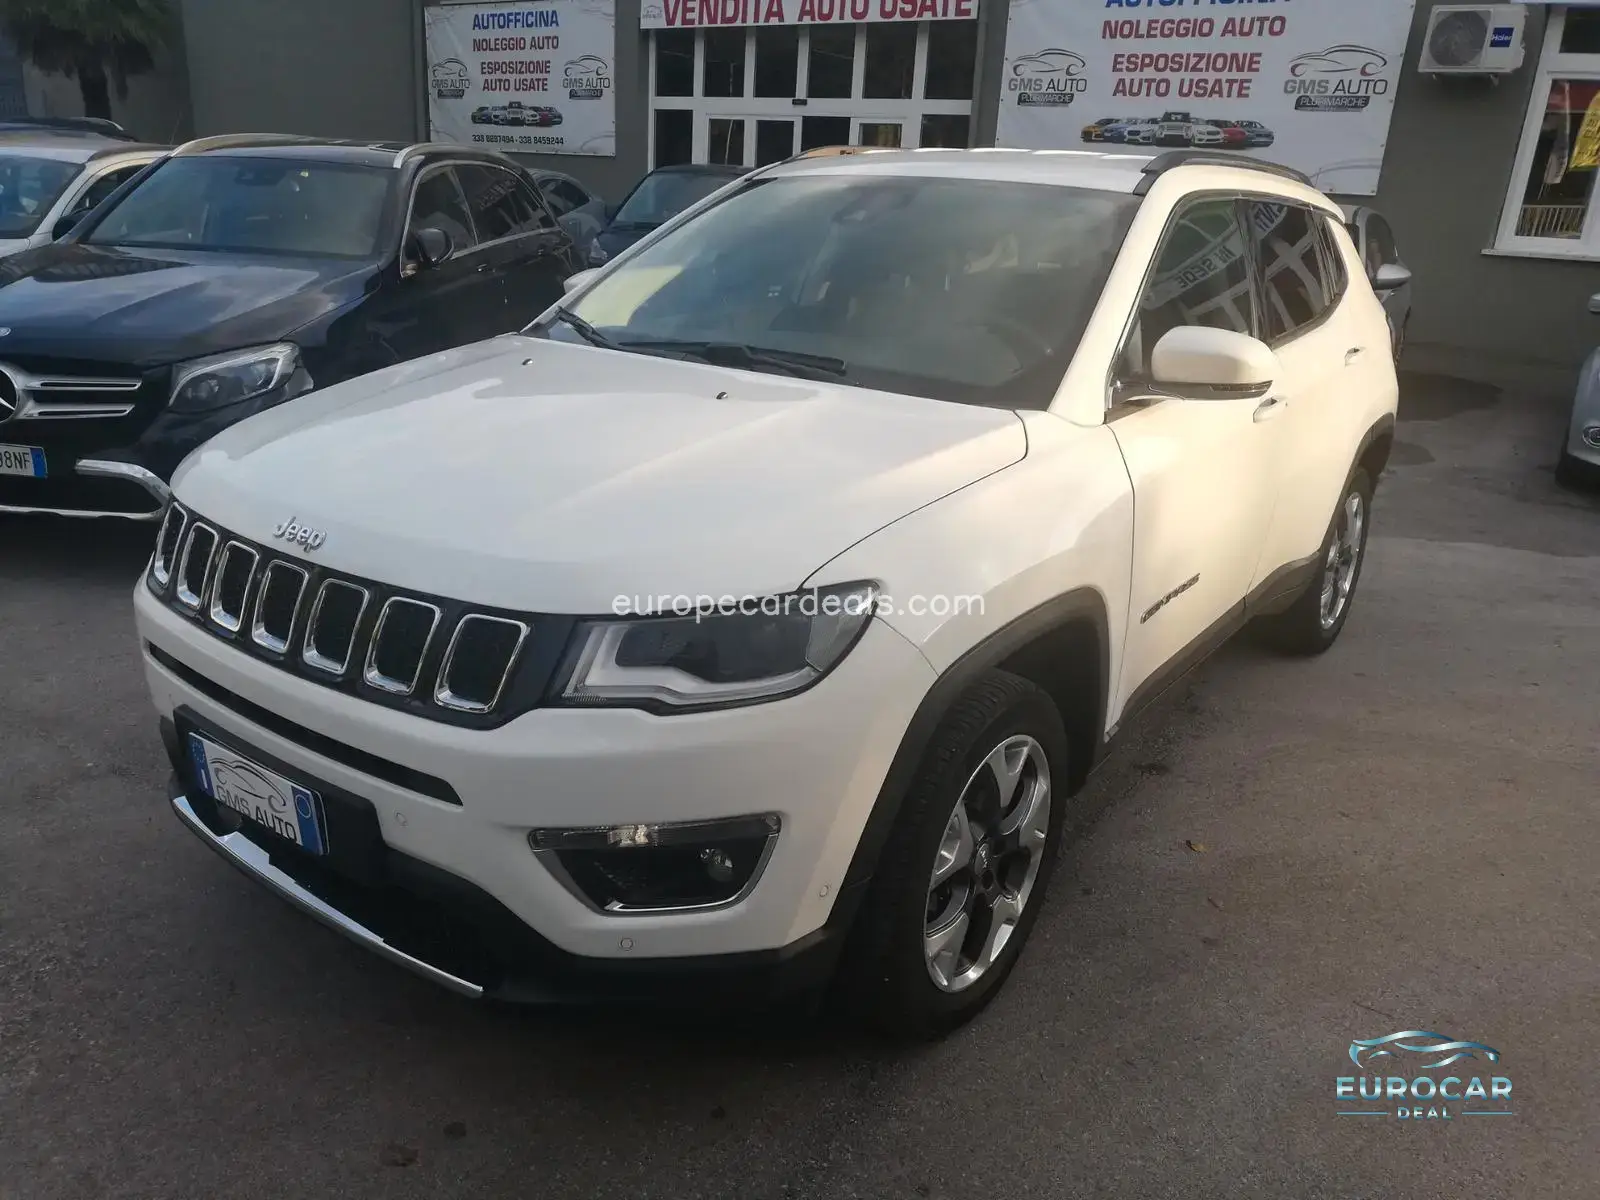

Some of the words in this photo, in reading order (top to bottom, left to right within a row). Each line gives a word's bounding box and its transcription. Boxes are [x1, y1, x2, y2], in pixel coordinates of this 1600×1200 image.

[473, 10, 559, 30] AUTOFFICINA
[663, 0, 785, 27] VENDITA
[797, 0, 869, 22] AUTO
[879, 0, 972, 19] USATE
[1102, 18, 1215, 39] NOLEGGIO
[1220, 16, 1287, 37] AUTO
[473, 37, 526, 52] NOLEGGIO
[530, 36, 559, 50] AUTO
[1491, 33, 1513, 41] Haier
[481, 60, 550, 75] ESPOSIZIONE
[1112, 53, 1262, 74] ESPOSIZIONE
[450, 79, 471, 89] AUTO
[483, 78, 511, 92] AUTO
[514, 78, 548, 92] USATE
[562, 78, 583, 89] GMS
[585, 77, 611, 89] AUTO
[1008, 78, 1043, 91] GMS
[1045, 78, 1088, 92] AUTO
[1112, 78, 1171, 97] AUTO
[1178, 78, 1252, 98] USATE
[1283, 79, 1329, 94] GMS
[1332, 79, 1388, 94] AUTO
[472, 134, 484, 143] 338
[519, 136, 532, 144] 338
[273, 516, 327, 553] Jeep
[216, 784, 250, 817] GMS
[255, 806, 297, 844] AUTO
